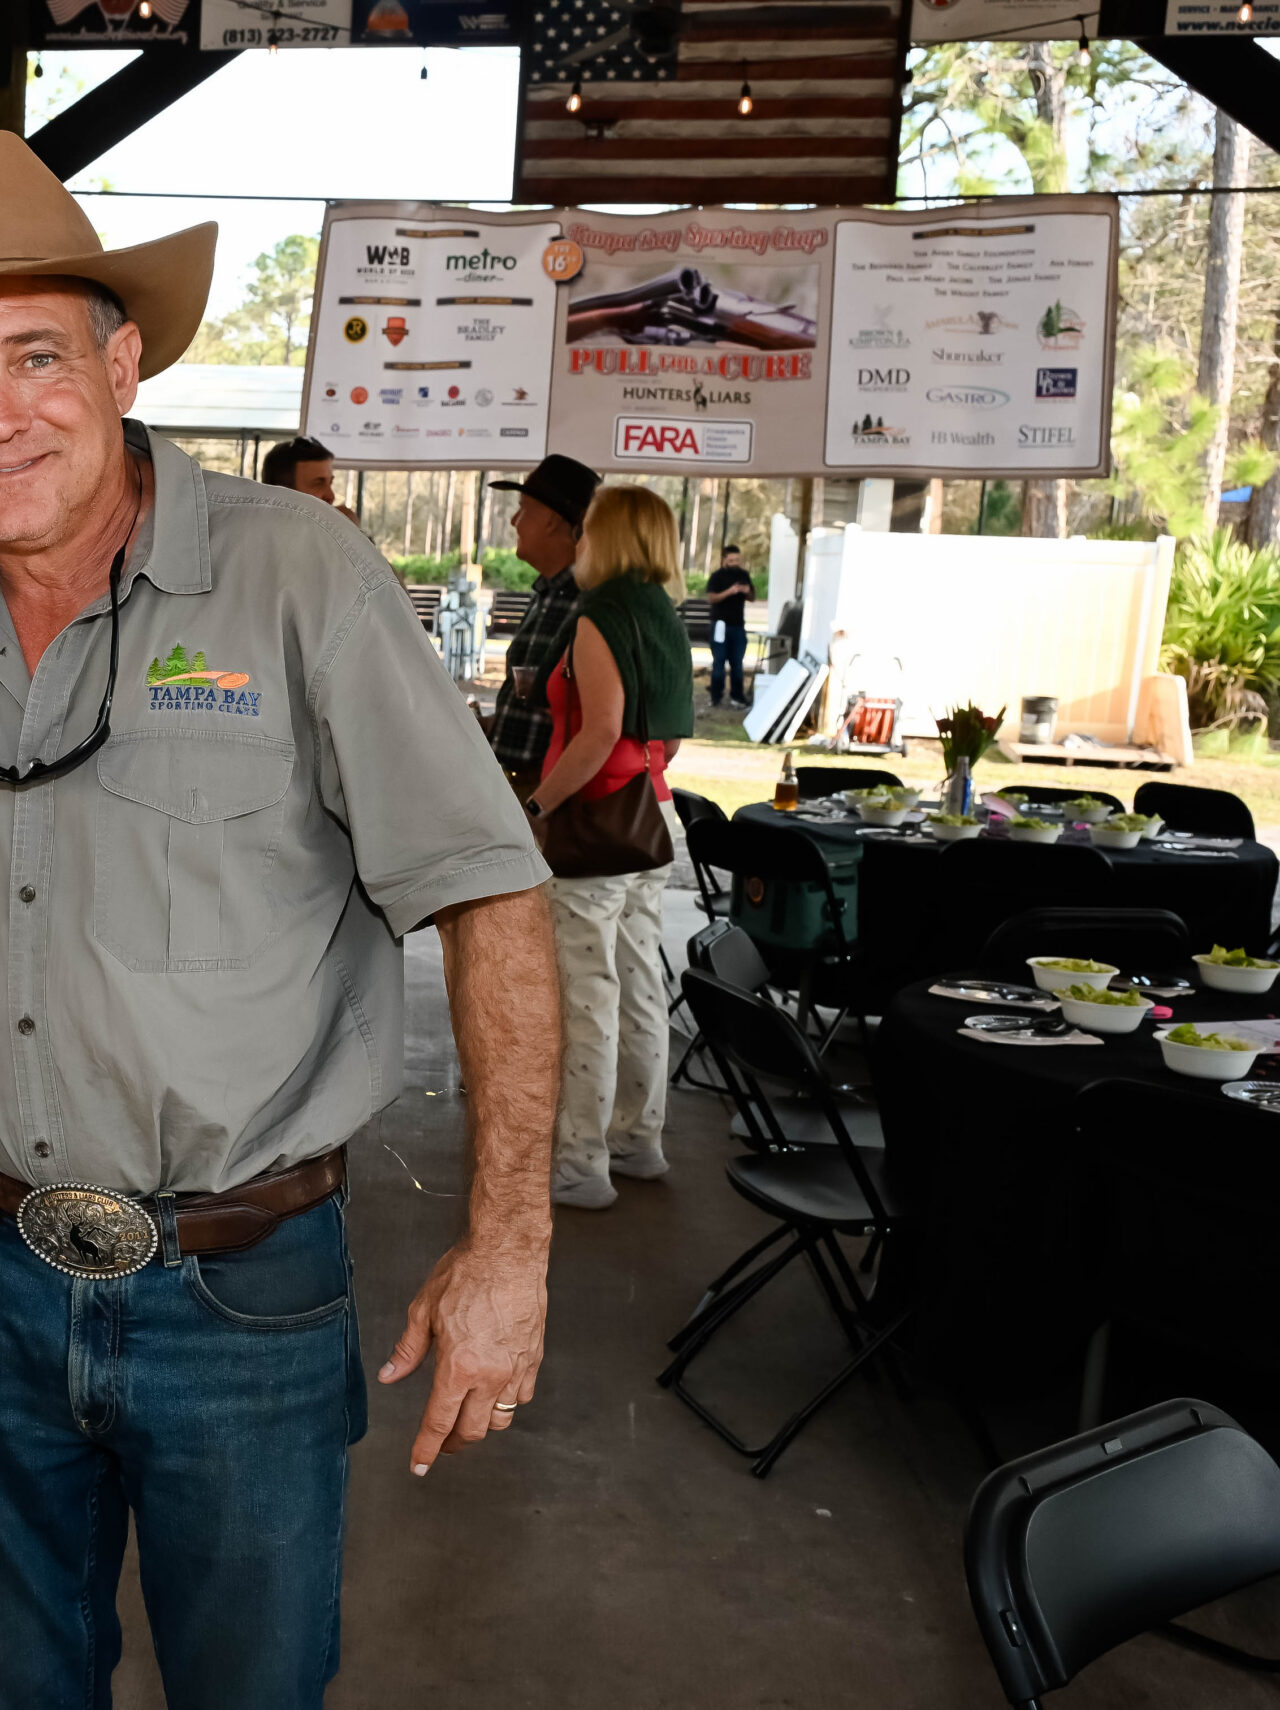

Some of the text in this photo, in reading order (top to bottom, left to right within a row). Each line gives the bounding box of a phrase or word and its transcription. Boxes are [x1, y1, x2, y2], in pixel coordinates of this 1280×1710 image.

[222, 30, 262, 46] (813)
[685, 223, 771, 256] Sporting
[445, 248, 519, 272] metro
[568, 348, 659, 377] PULL
[717, 351, 812, 382] CURE
[857, 368, 911, 386] DMD
[623, 387, 752, 405] HUNTERS LIARS
[926, 388, 996, 404] GASTRO
[624, 425, 700, 456] FARA
[852, 436, 911, 445] TAMPA BAY
[950, 431, 996, 447] Wealth
[1018, 424, 1076, 443] STIFEL
[149, 686, 263, 708] TAMPA BAY
[150, 701, 260, 717] SPORTING CLAYS
[97, 1196, 114, 1208] CLUB
[119, 1231, 150, 1243] 2011
